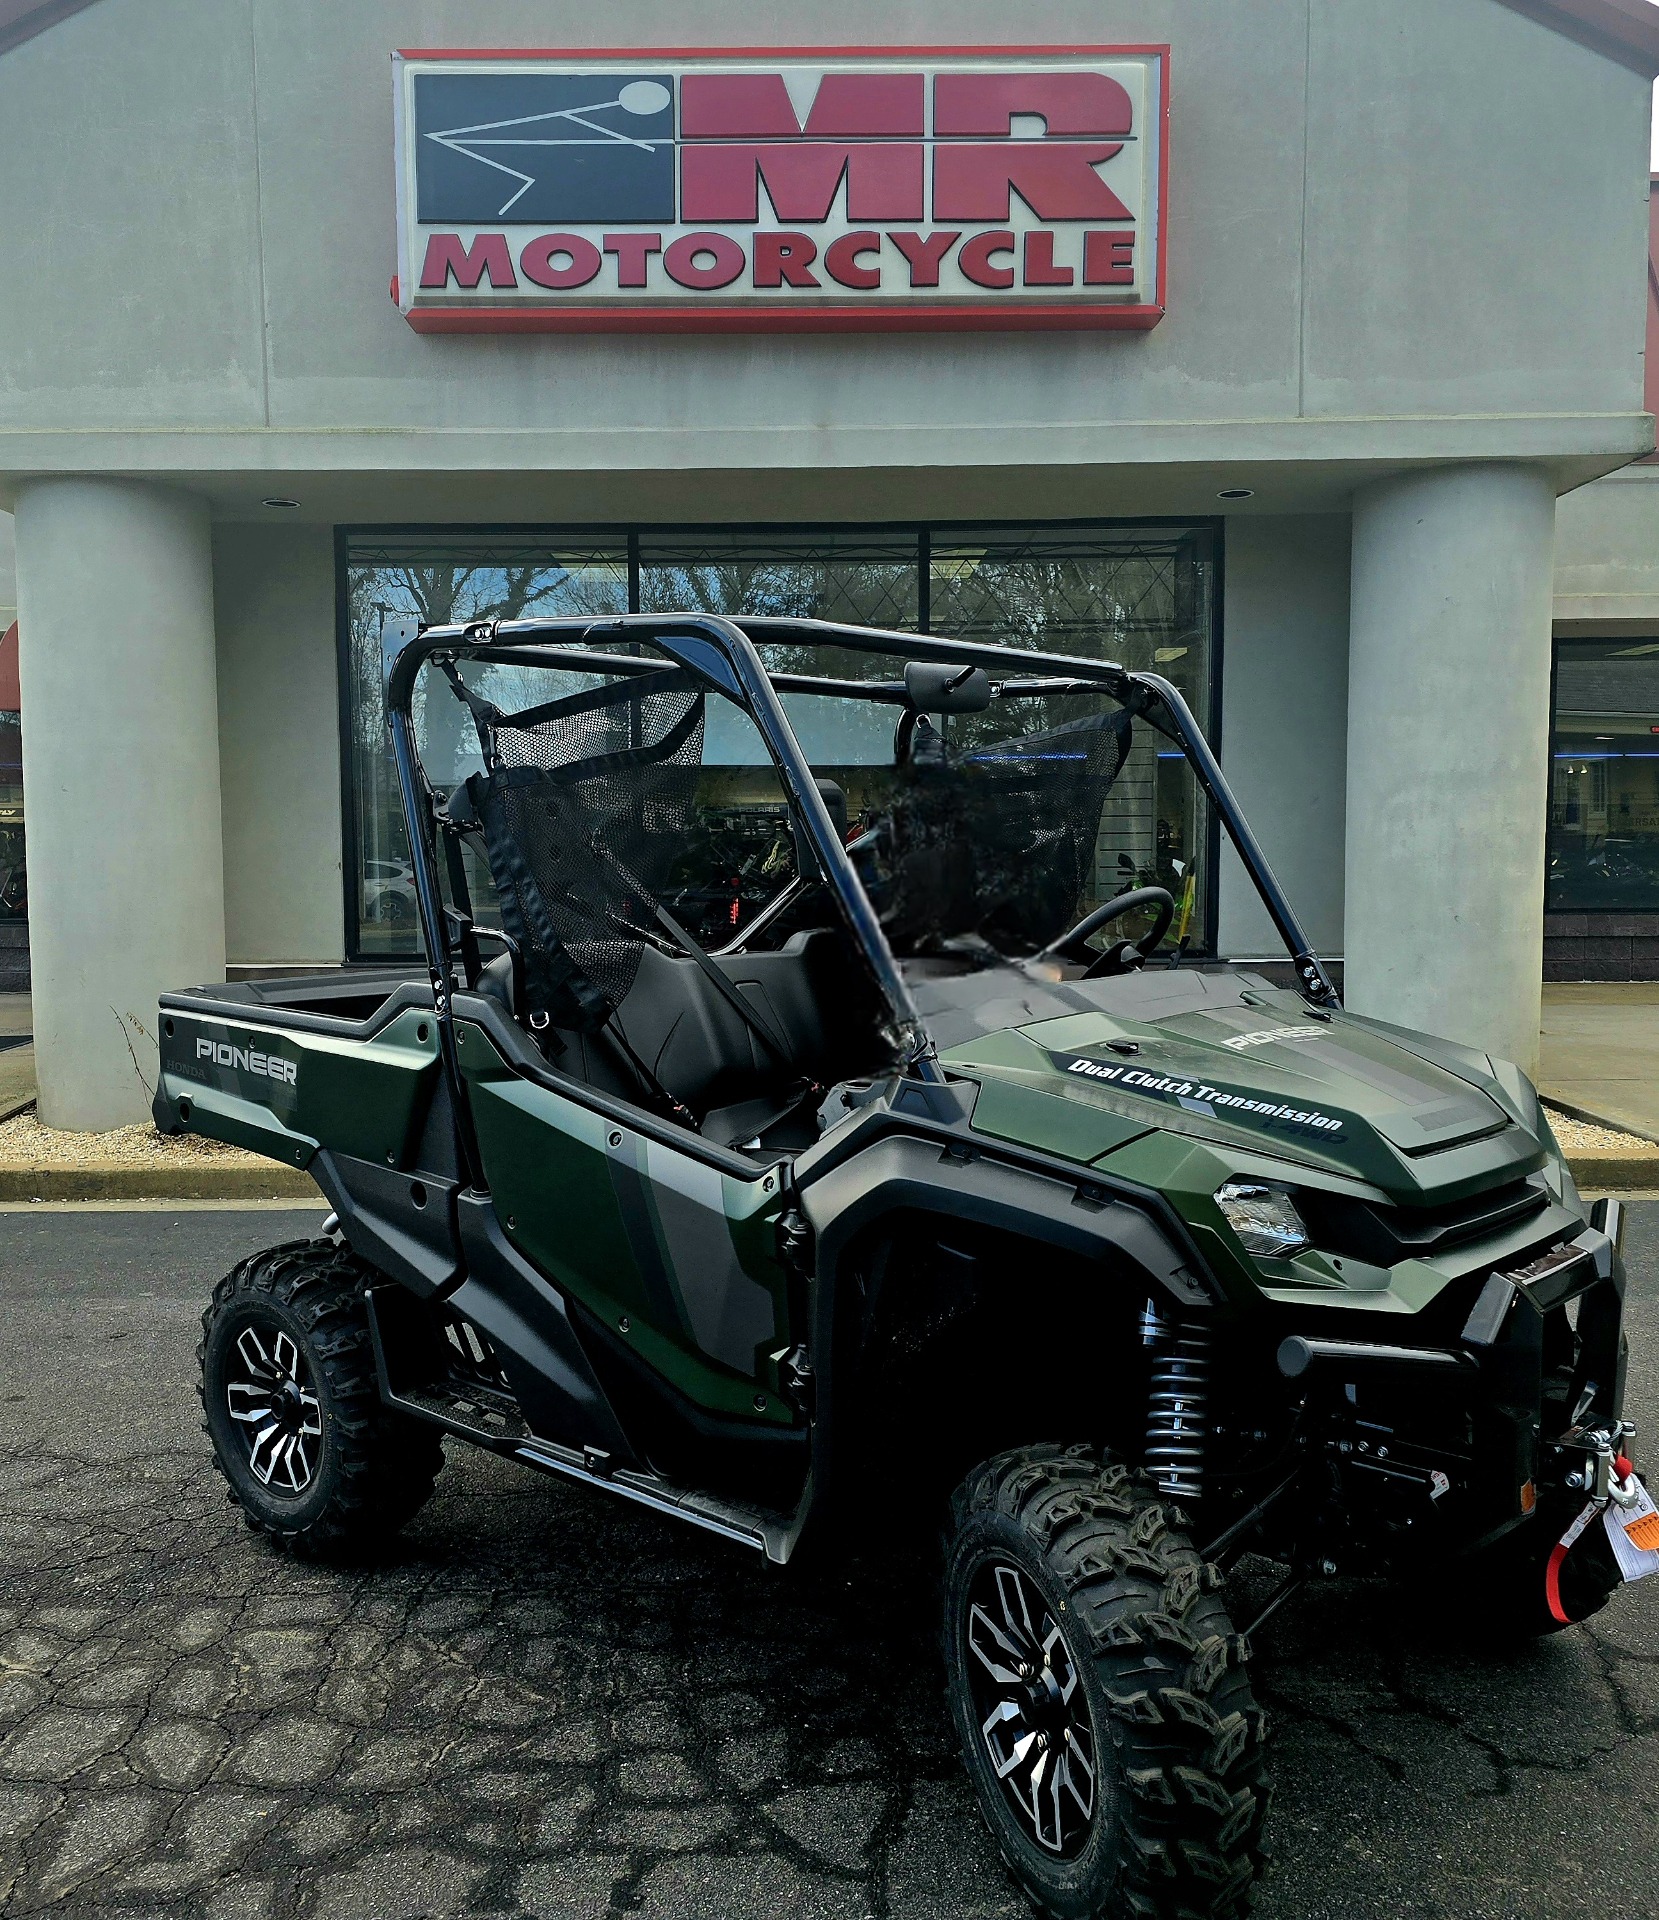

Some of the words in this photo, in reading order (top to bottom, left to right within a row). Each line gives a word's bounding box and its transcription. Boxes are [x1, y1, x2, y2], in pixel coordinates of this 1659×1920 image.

[680, 72, 1136, 223] MR
[418, 231, 1136, 291] MOTORCYCLE
[196, 1037, 298, 1086] PIONEER
[1220, 1025, 1335, 1050] PIONEER
[166, 1058, 207, 1080] HONDA
[1067, 1058, 1124, 1080] Dual
[1121, 1069, 1194, 1097] Clutch
[1195, 1085, 1344, 1131] Transmission
